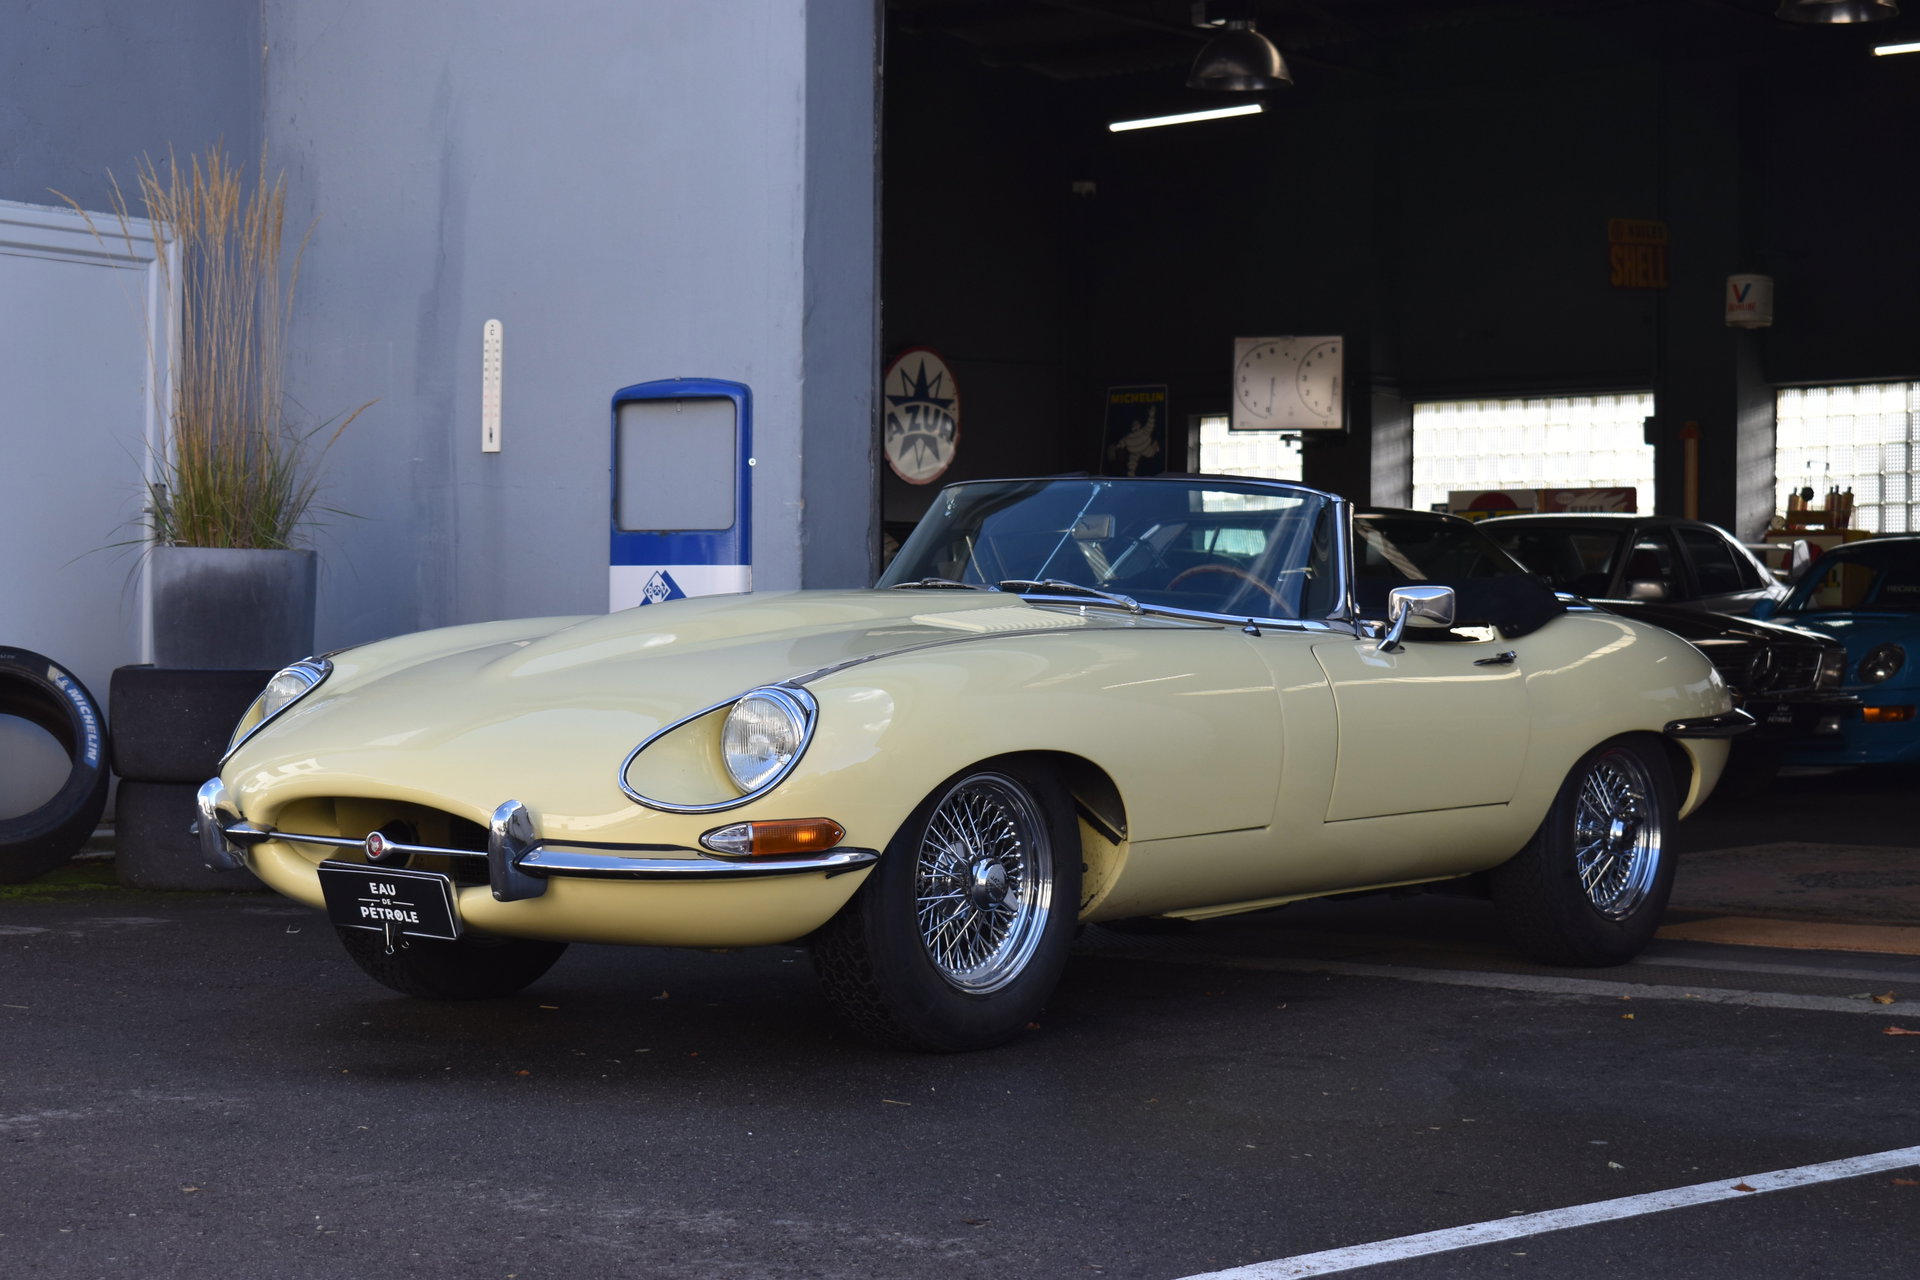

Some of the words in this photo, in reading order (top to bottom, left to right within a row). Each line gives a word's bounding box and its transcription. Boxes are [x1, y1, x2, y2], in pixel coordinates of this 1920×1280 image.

[1610, 247, 1667, 287] SHELL
[1110, 392, 1164, 404] MICHELIN
[887, 404, 956, 445] AZUR
[67, 688, 98, 761] MICHELIN
[369, 882, 396, 896] EAU
[381, 898, 392, 906] DE
[360, 903, 420, 924] PÉTROLE
